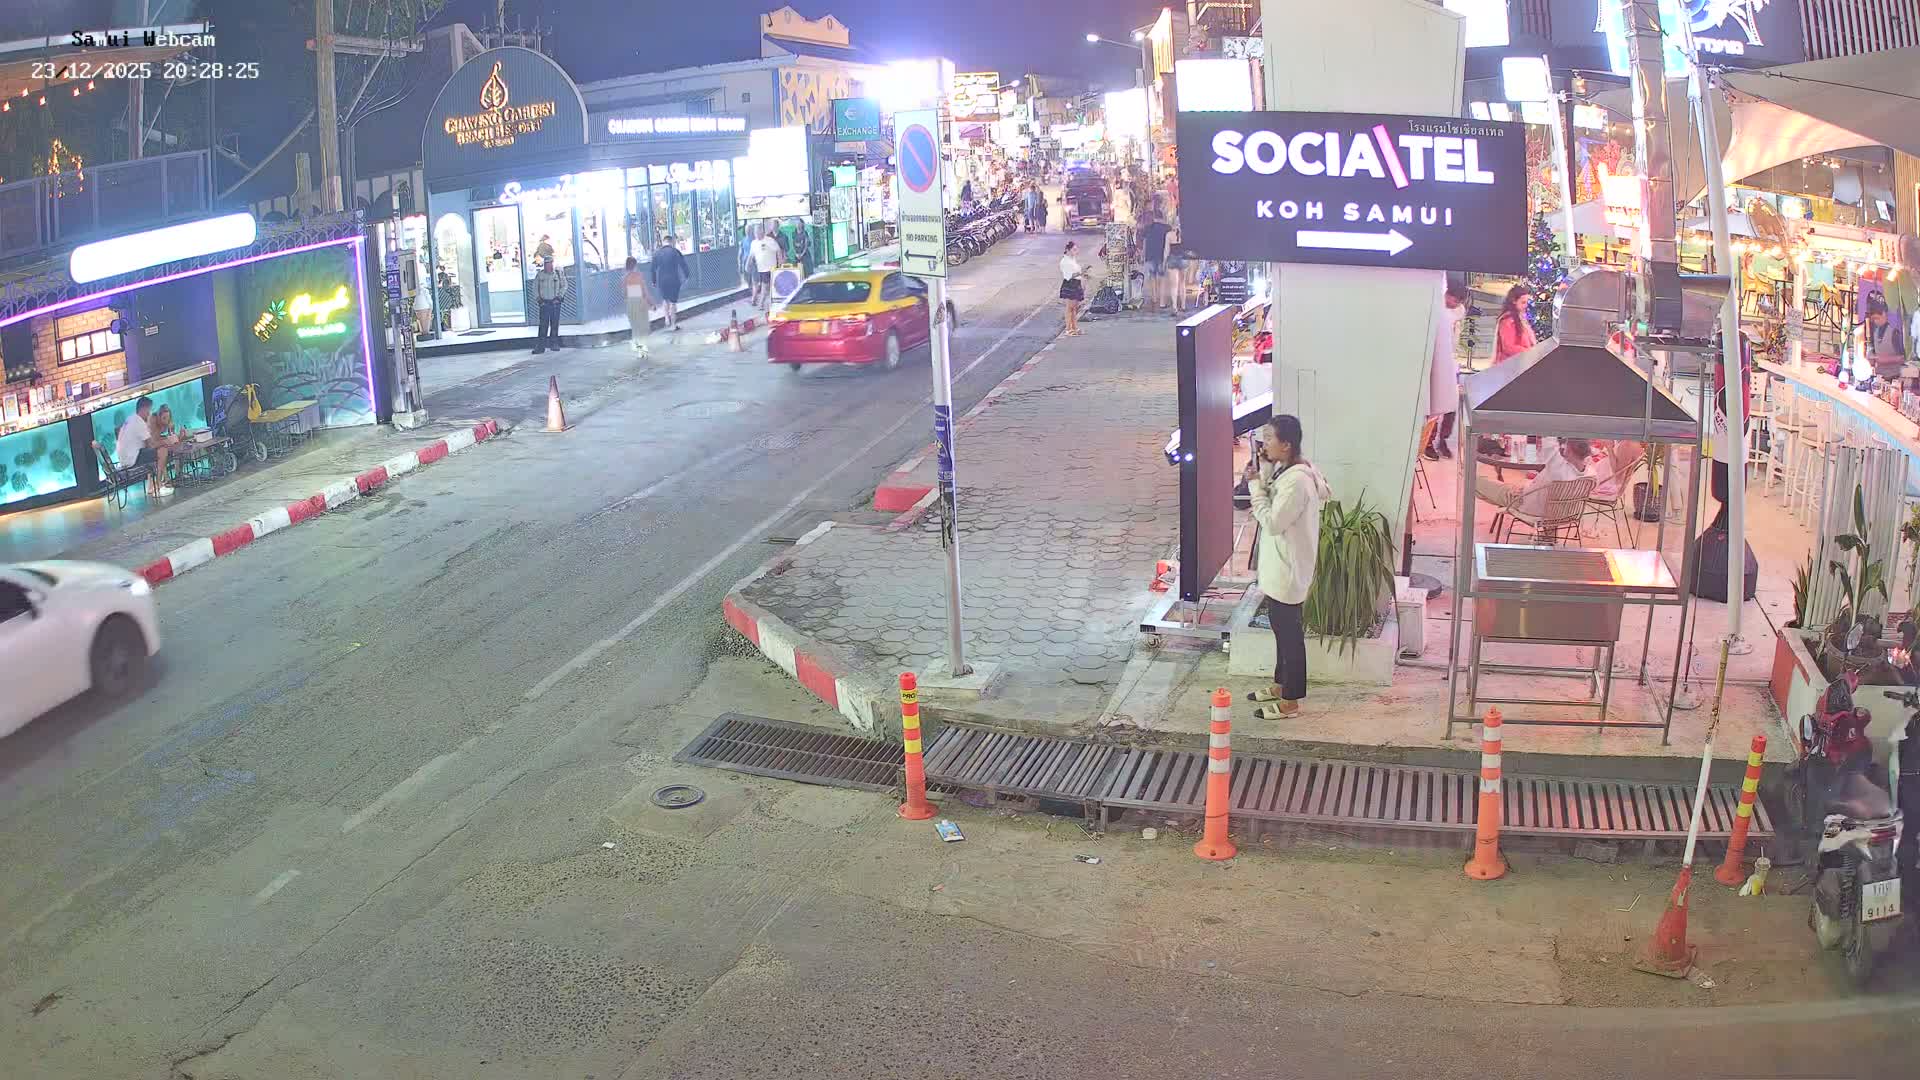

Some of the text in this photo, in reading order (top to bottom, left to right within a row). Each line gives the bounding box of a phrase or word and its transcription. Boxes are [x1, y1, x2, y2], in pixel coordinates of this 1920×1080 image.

[837, 126, 878, 136] EXCHANGE
[1256, 199, 1453, 226] KOH SAMUI
[906, 233, 938, 243] NO PARKING
